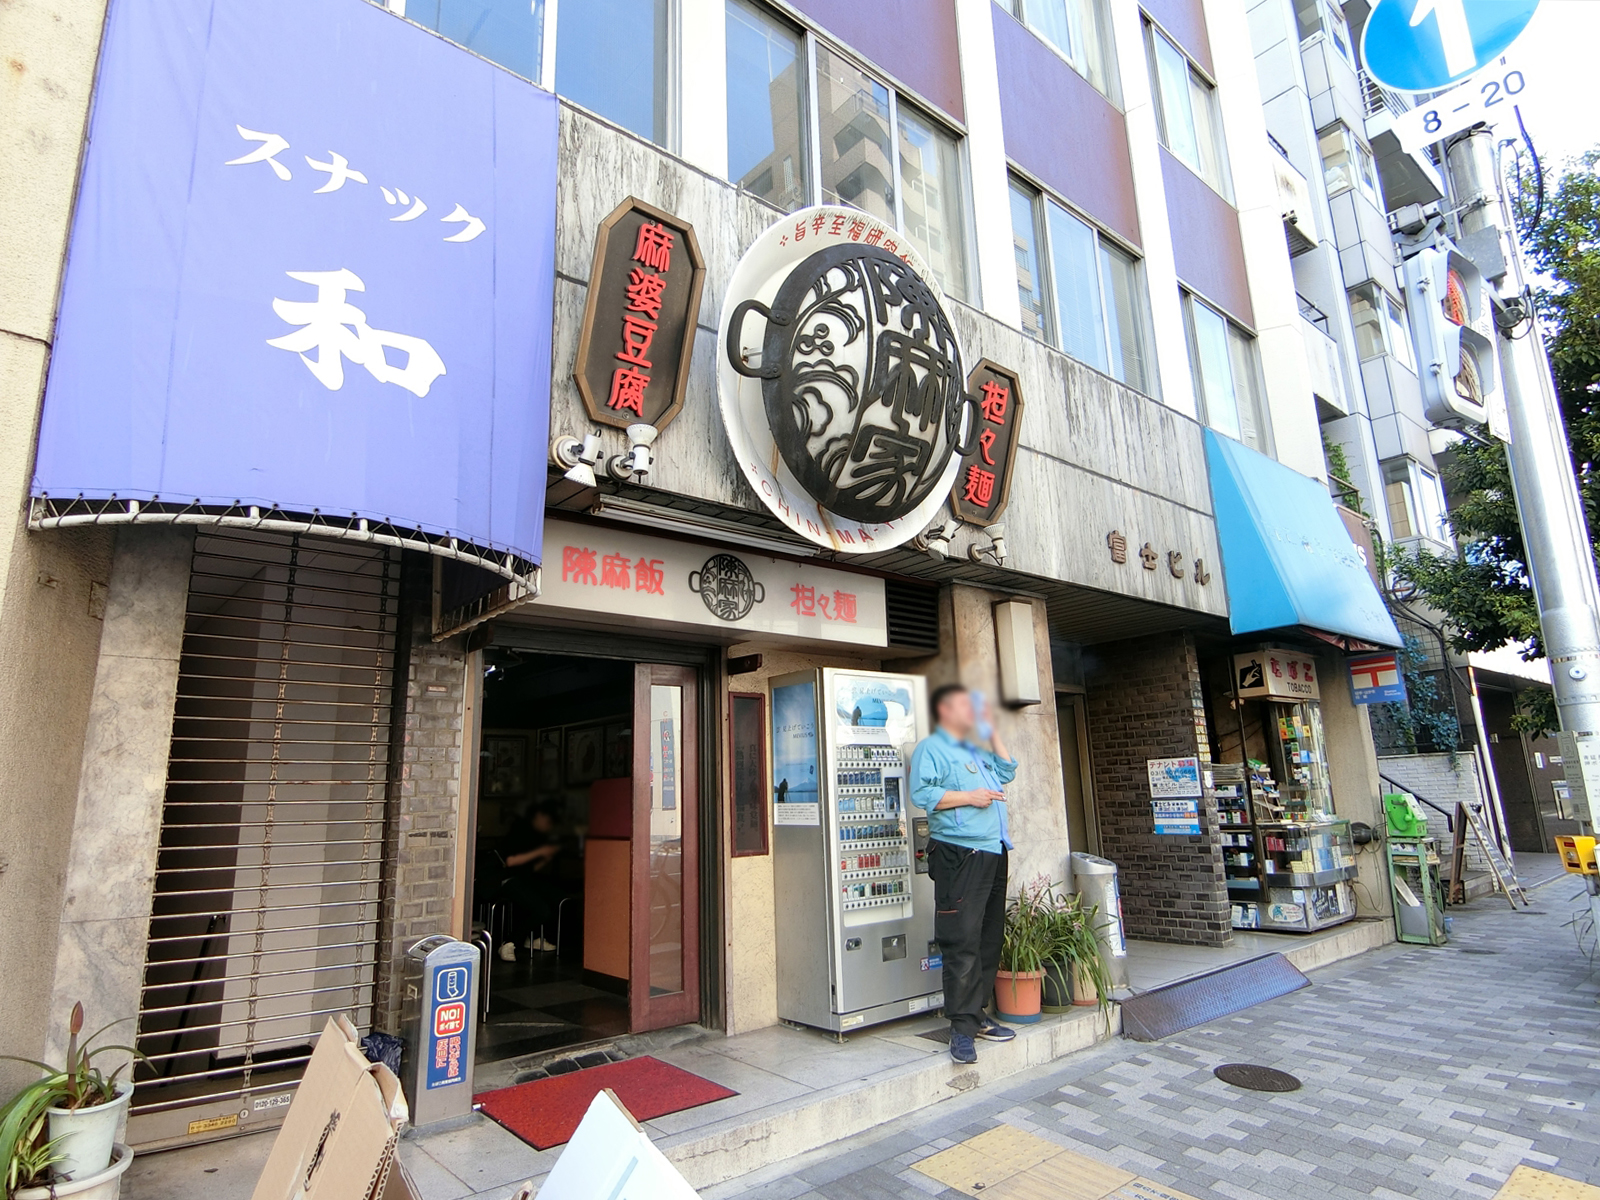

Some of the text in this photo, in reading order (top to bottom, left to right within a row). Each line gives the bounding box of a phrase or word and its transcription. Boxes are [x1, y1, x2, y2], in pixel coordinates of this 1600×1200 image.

[265, 267, 447, 398] 和
[606, 222, 675, 418] 麻婆豆腐
[561, 545, 665, 596] 陳麻飯
[789, 582, 858, 624] 担々麺
[1270, 656, 1314, 683] たばこ
[1286, 681, 1313, 695] TOBACCO
[440, 1008, 461, 1022] NO!
